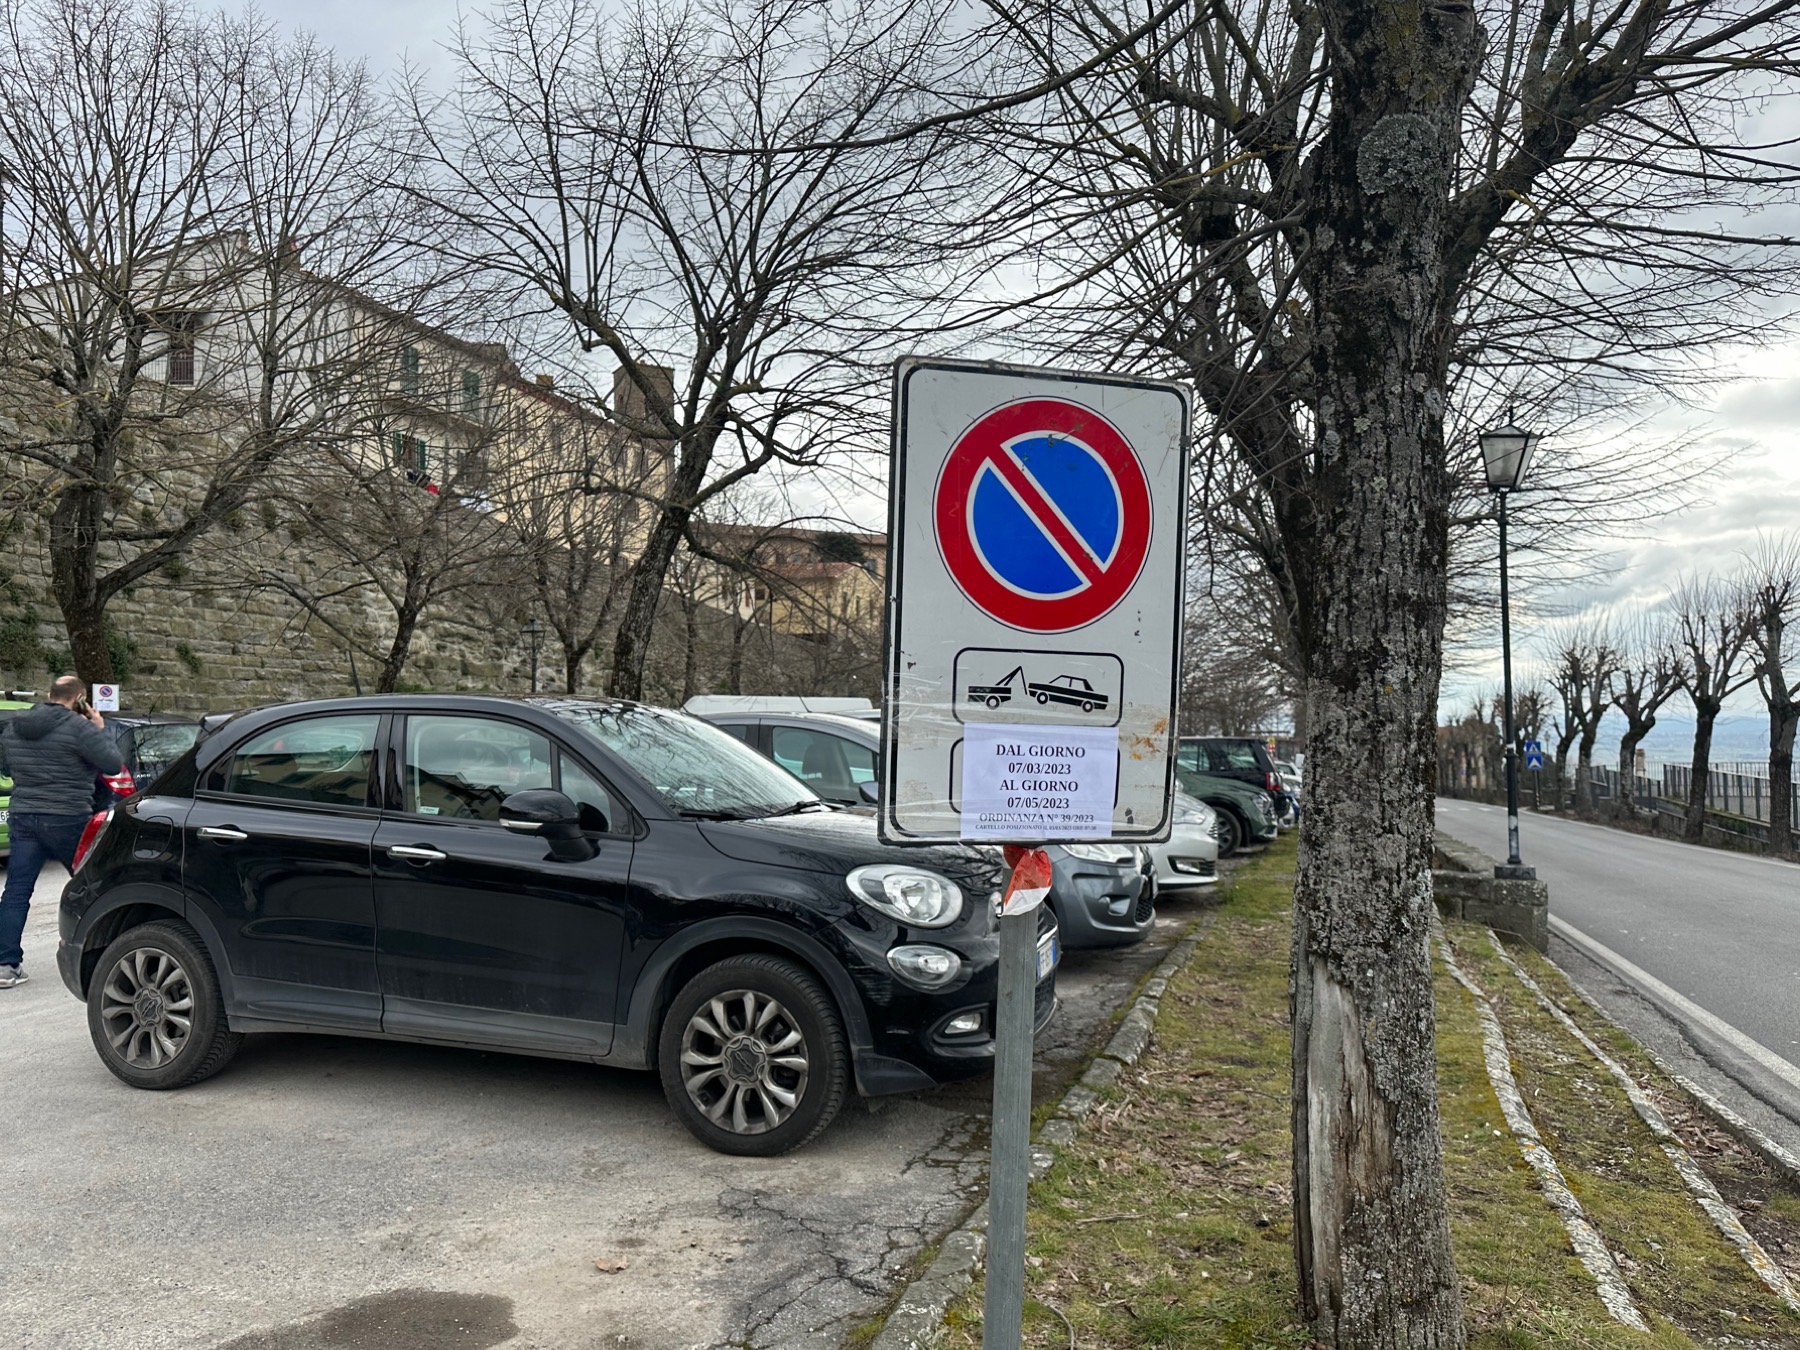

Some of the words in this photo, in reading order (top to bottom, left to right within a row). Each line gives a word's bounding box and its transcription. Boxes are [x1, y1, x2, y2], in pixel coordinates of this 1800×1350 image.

[996, 744, 1025, 756] DAL
[1028, 745, 1086, 758] GIORNO
[1008, 762, 1071, 775] 07/03/2023
[999, 779, 1019, 791] AL
[1021, 780, 1079, 792] GIORNO
[1007, 797, 1070, 809] 07/05/2023
[979, 812, 1044, 823] ORDINANZA
[1047, 813, 1059, 823] N°
[1060, 814, 1094, 823] 39/2023
